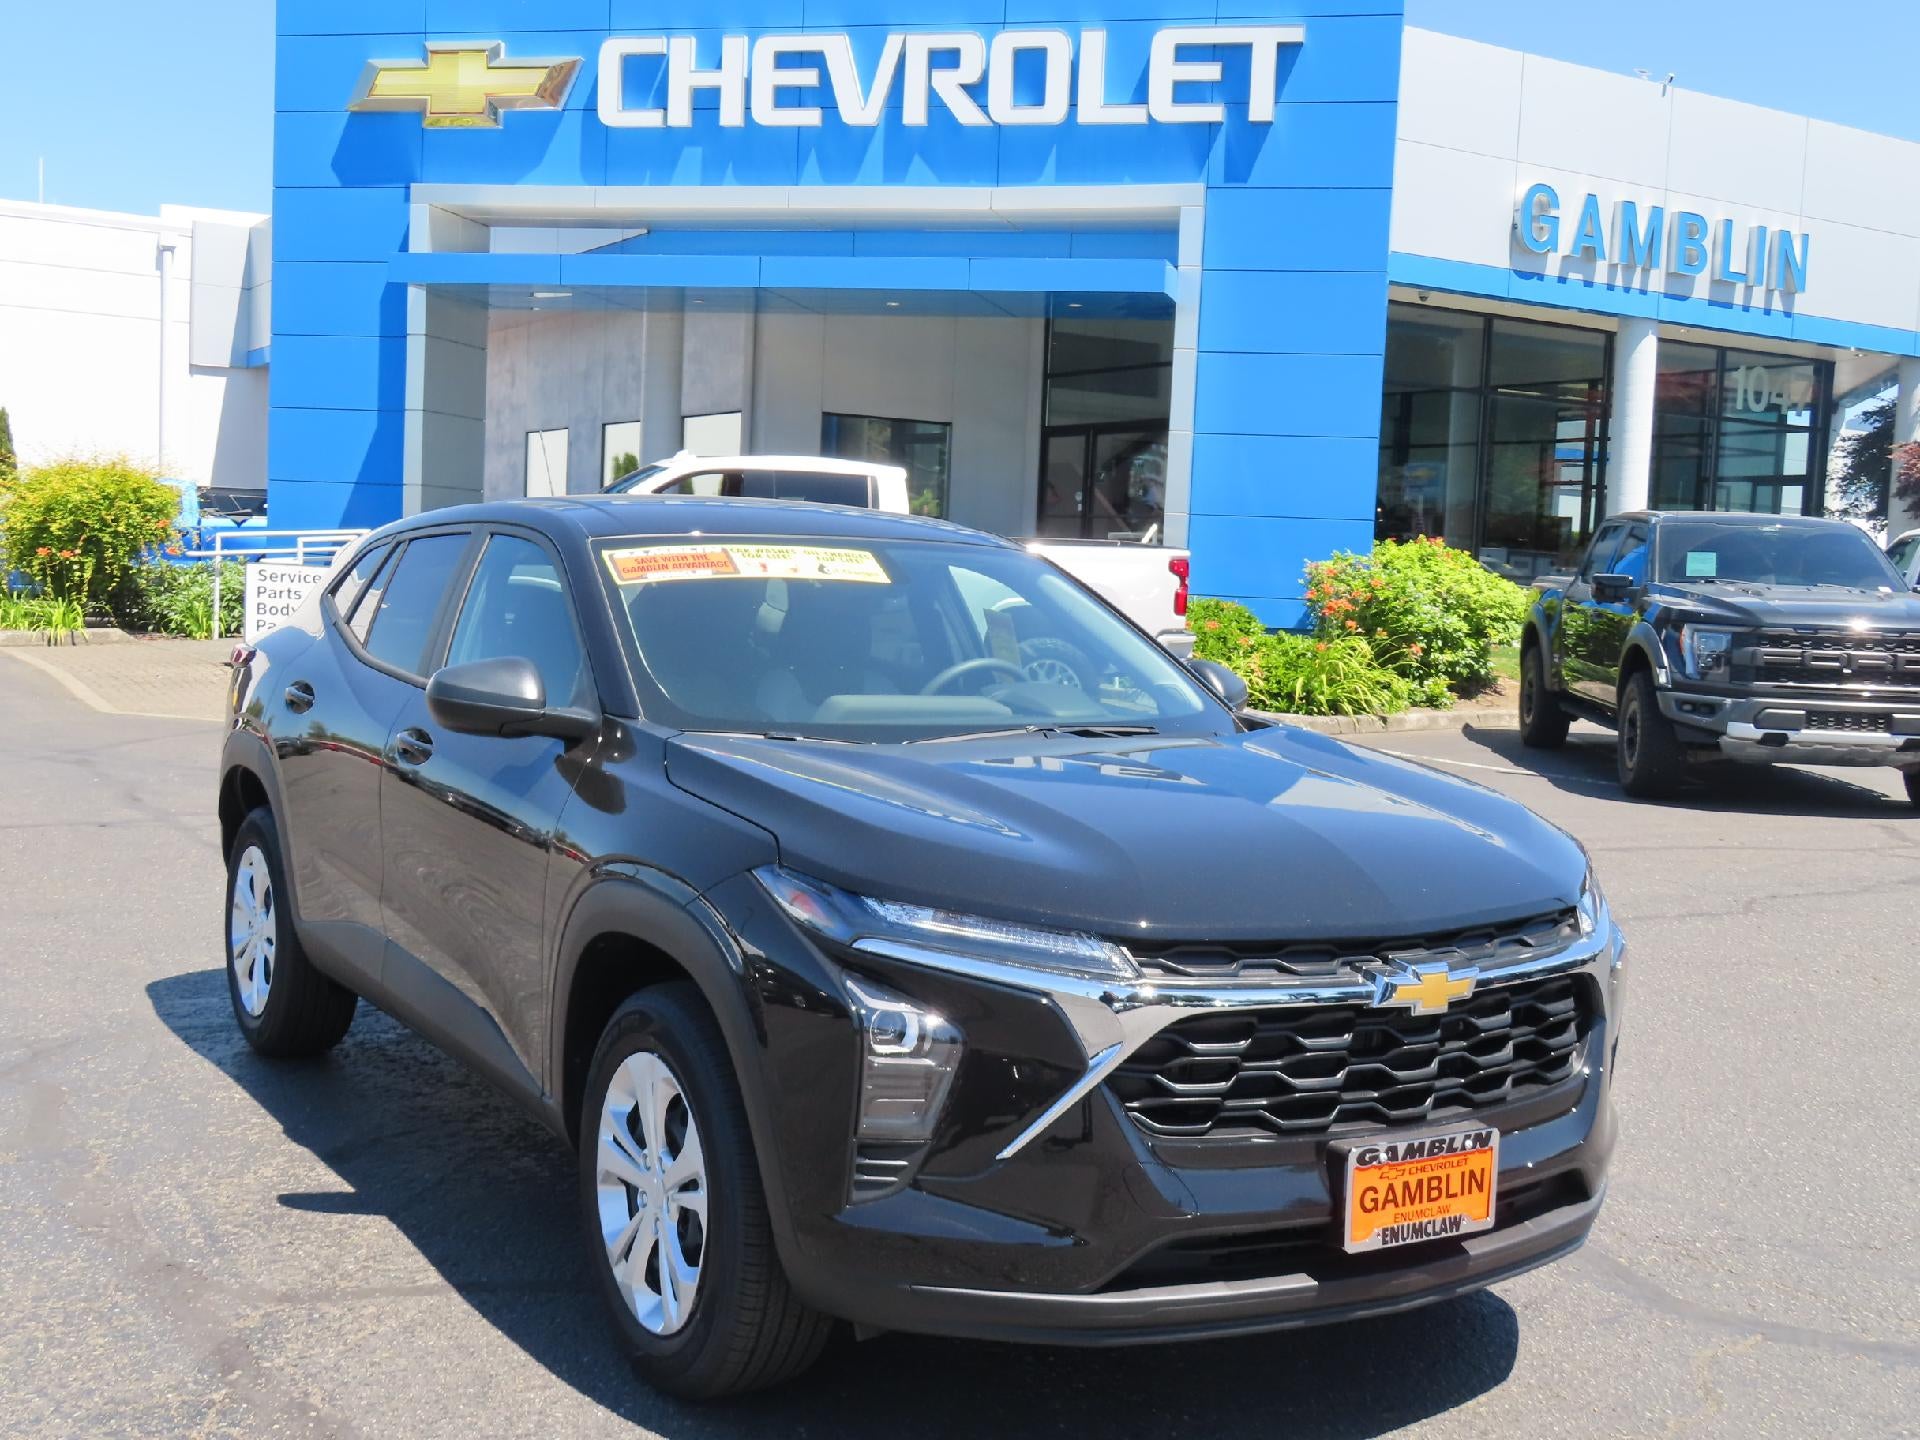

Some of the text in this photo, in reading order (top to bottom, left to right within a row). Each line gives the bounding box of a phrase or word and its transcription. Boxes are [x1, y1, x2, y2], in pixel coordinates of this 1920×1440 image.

[597, 25, 1305, 128] CHEVROLET
[1517, 183, 1809, 294] GAMBLIN
[622, 560, 730, 574] GAMBLIN ADVANTAGE
[634, 553, 711, 565] SAVE WITH THE
[258, 568, 322, 583] Service
[256, 586, 302, 600] Parts
[1356, 1130, 1493, 1167] GAMBLIN
[1408, 1157, 1469, 1176] CHEVROLET
[1359, 1167, 1486, 1214] GAMBLIN
[1393, 1204, 1451, 1224] ENUMCLAW
[1381, 1214, 1464, 1246] ENUMCLAW
